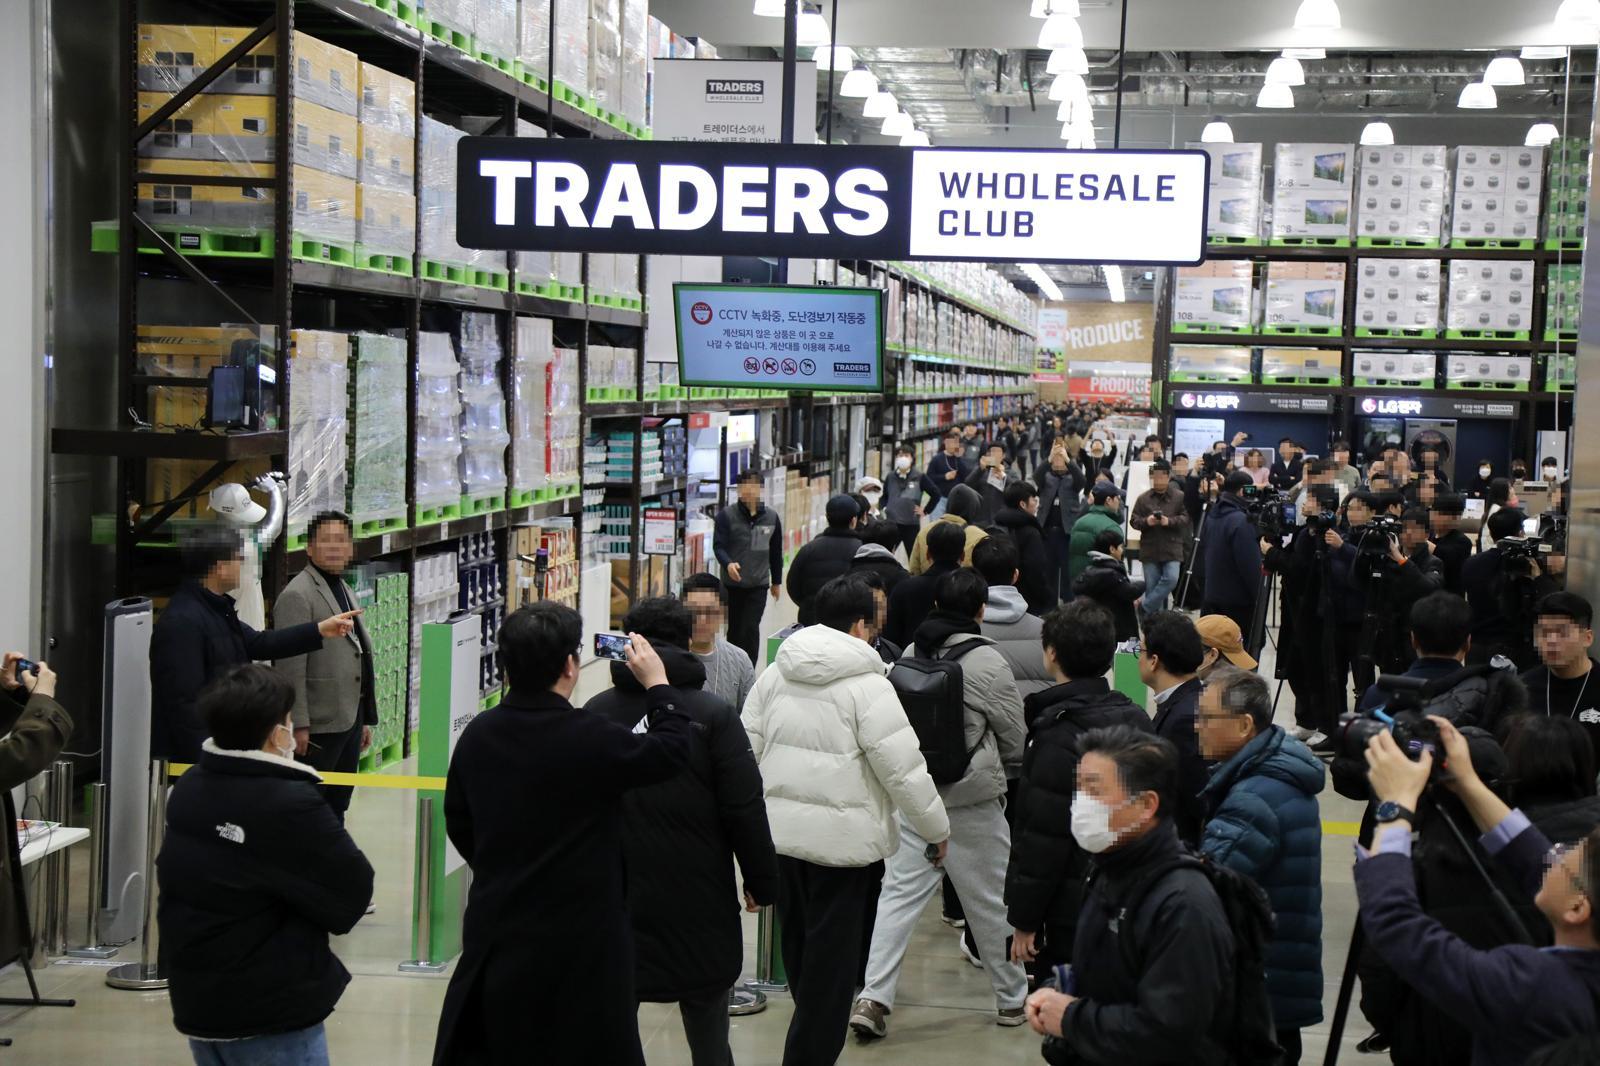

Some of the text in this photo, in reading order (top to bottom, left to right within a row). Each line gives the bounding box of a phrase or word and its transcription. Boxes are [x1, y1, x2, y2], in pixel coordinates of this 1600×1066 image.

[708, 82, 762, 92] TRADERS
[703, 124, 765, 135] 트레이더스에서
[940, 172, 1175, 201] WHOLESALE
[480, 160, 888, 236] TRADERS
[939, 210, 1033, 237] CLUB
[719, 309, 866, 325] CCTV 녹화중, 도난경보기 작동중
[723, 328, 753, 338] 계산되지
[755, 329, 771, 339] 않은
[773, 329, 796, 340] 상품은
[707, 339, 852, 353] 나갈 수 없습니다. 계산대를 이용해 주세요
